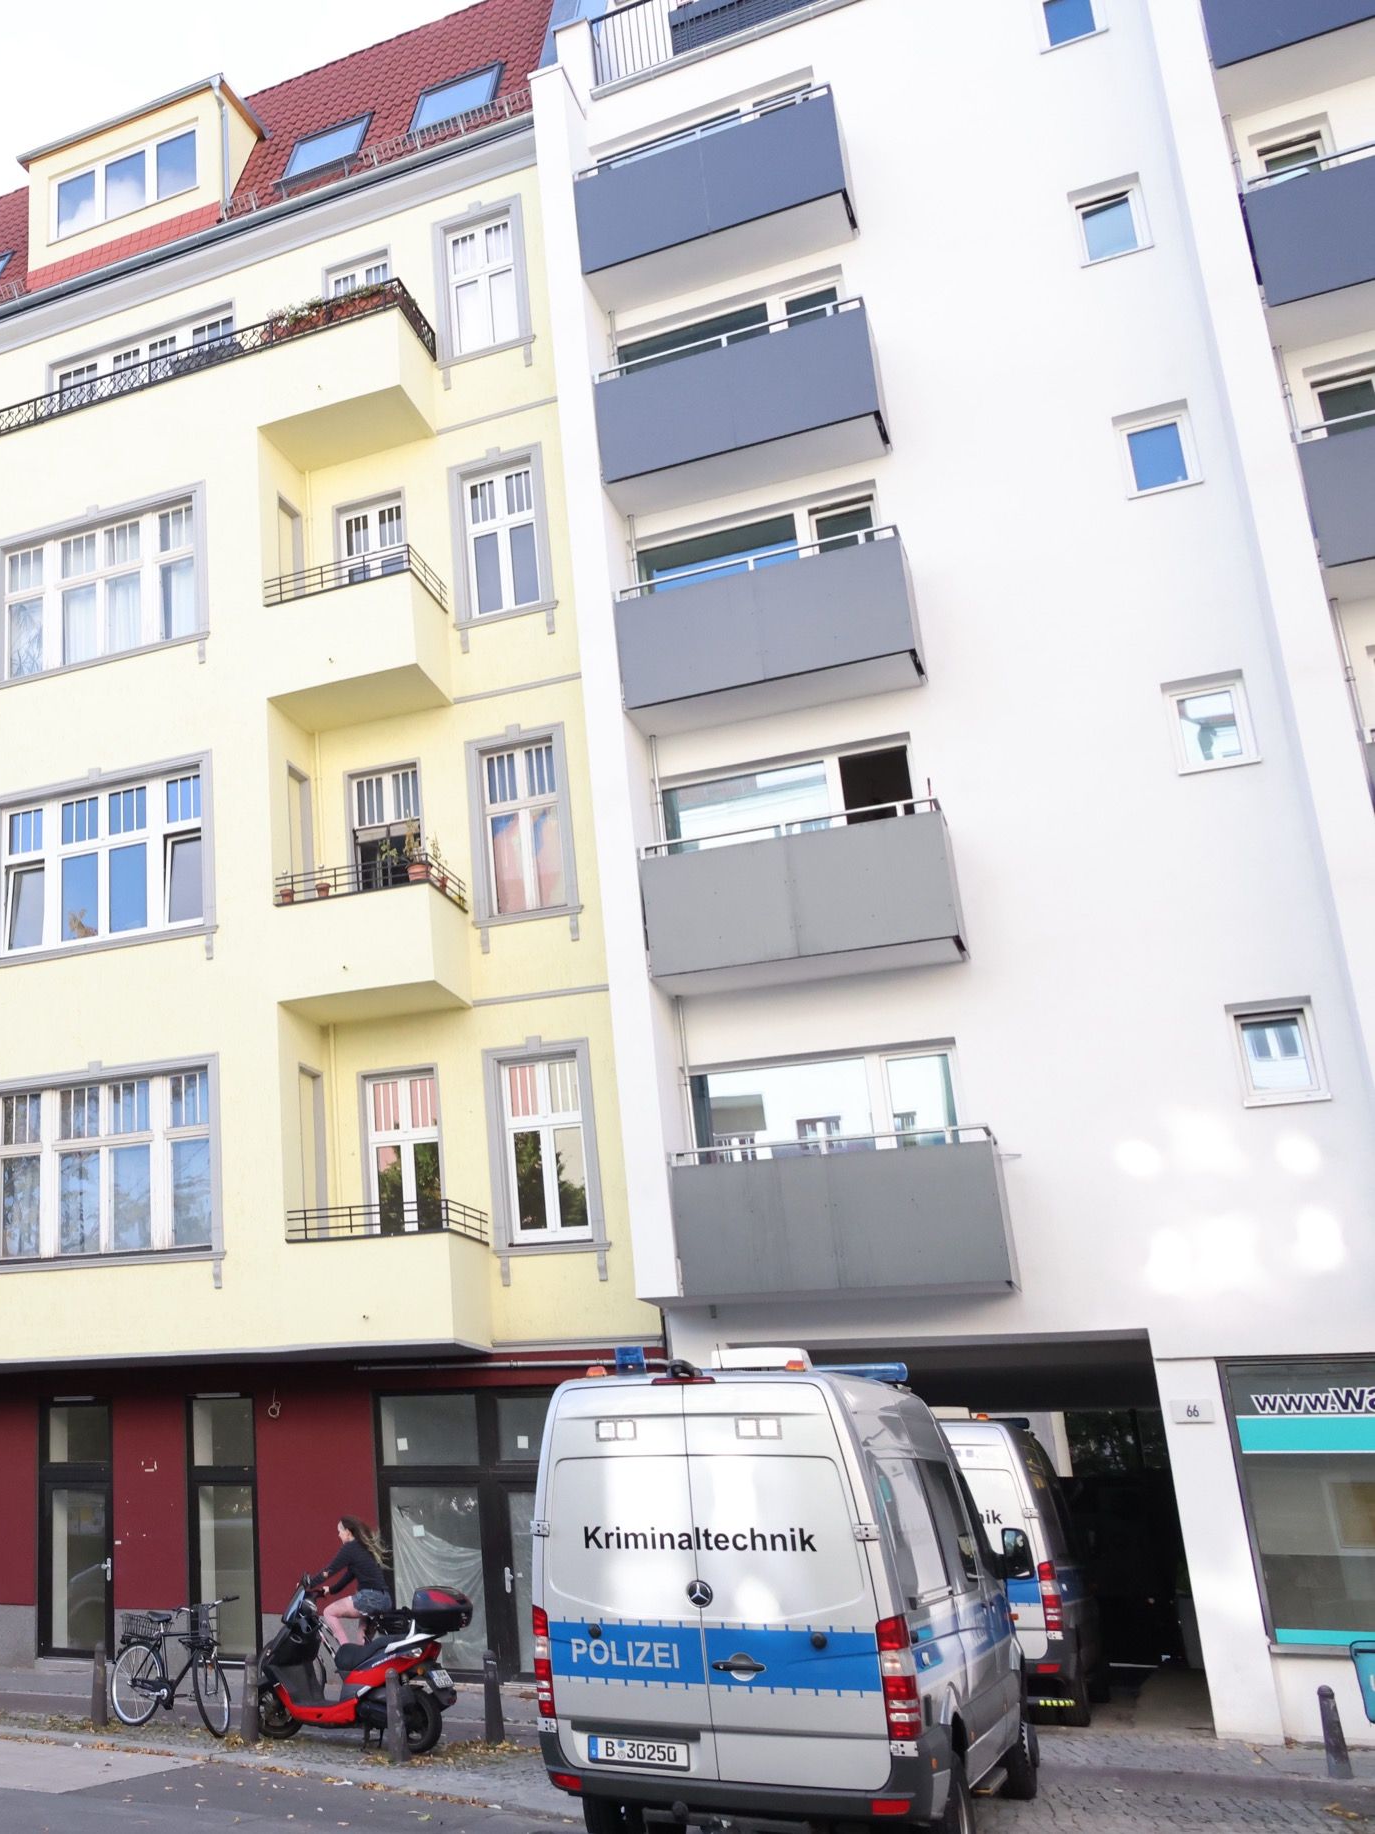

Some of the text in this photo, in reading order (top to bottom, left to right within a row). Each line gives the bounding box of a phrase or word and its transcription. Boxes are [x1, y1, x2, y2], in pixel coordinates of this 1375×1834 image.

[1187, 1405, 1200, 1417] 66
[583, 1526, 817, 1552] Kriminaltechnik
[570, 1638, 681, 1669] POLIZEI
[605, 1740, 678, 1763] B 30250
